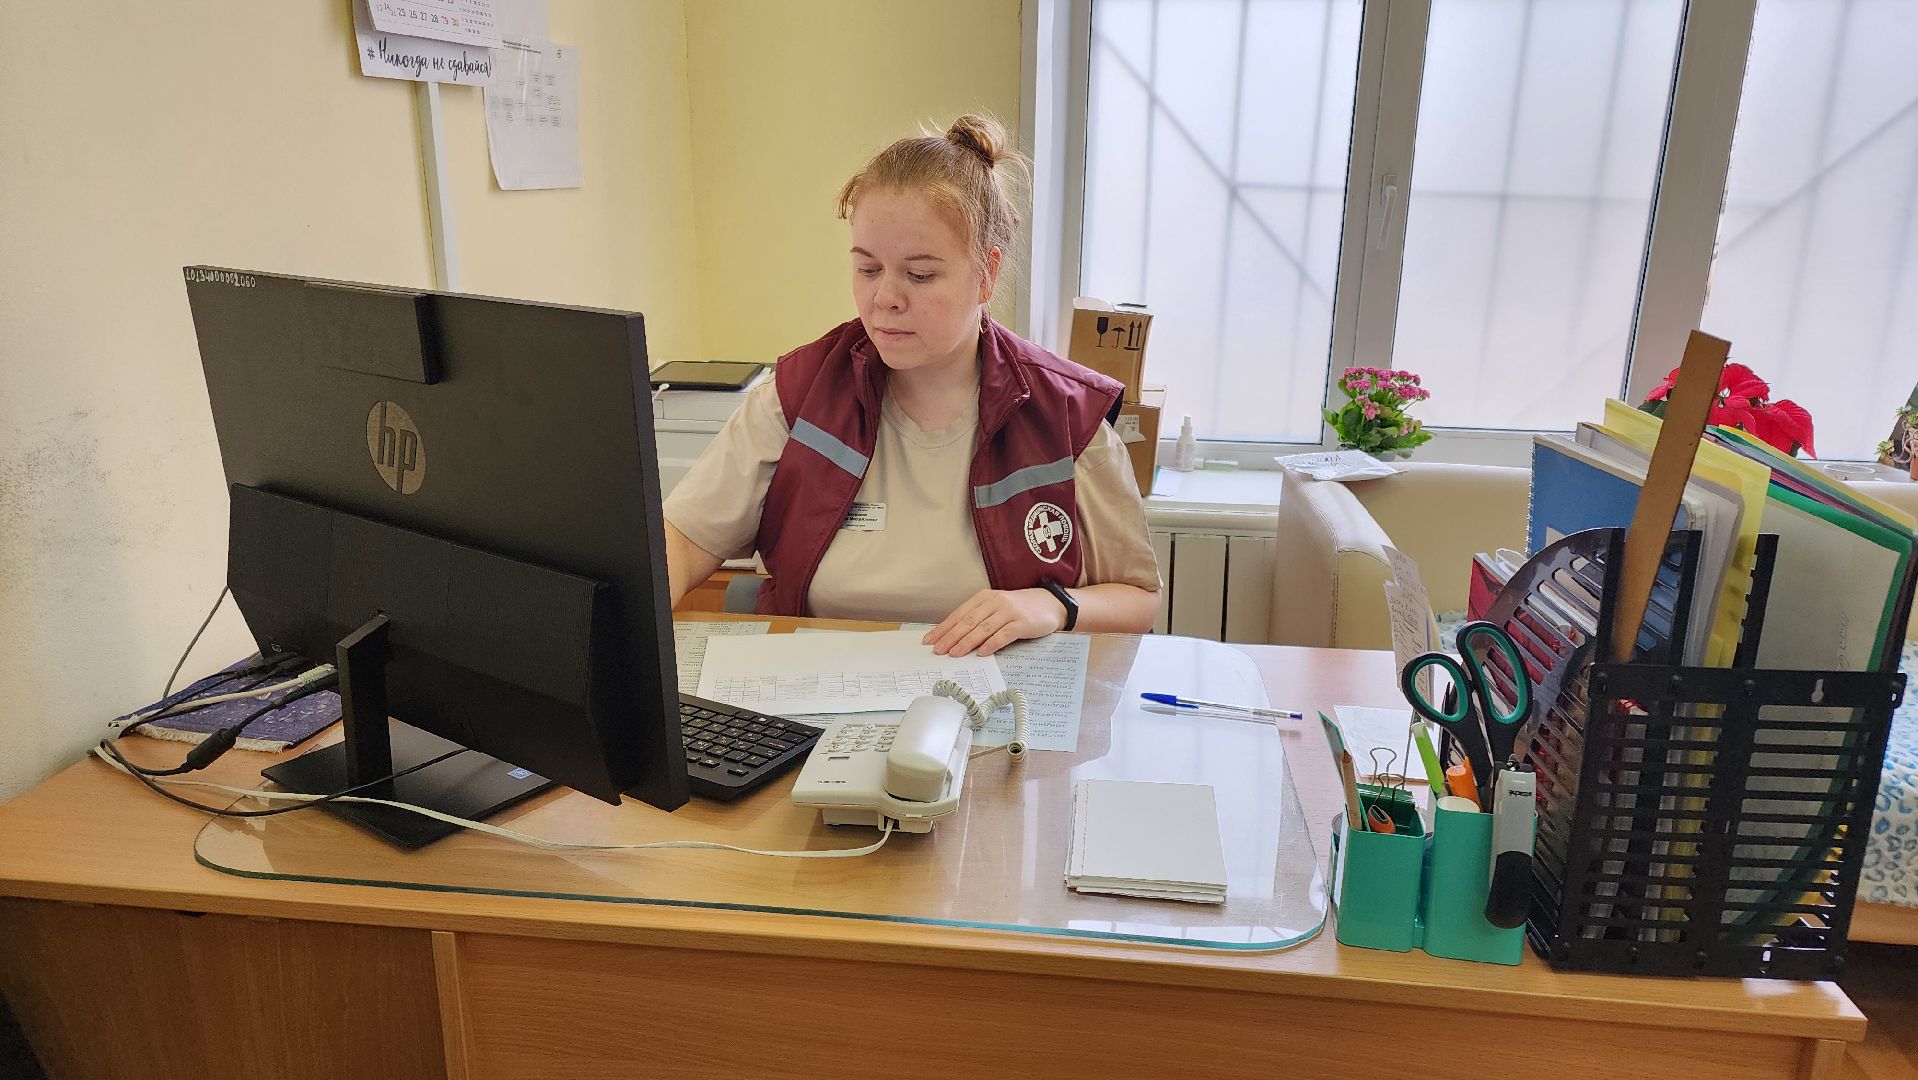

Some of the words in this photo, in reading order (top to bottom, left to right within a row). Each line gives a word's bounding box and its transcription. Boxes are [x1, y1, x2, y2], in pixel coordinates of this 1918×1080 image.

[397, 7, 406, 17] 25
[408, 9, 418, 20] 26
[420, 11, 427, 21] 27
[430, 13, 439, 23] 28
[379, 36, 429, 78] Никогда
[433, 56, 445, 70] не
[448, 50, 492, 81] сдавайся!
[370, 399, 423, 495] hp
